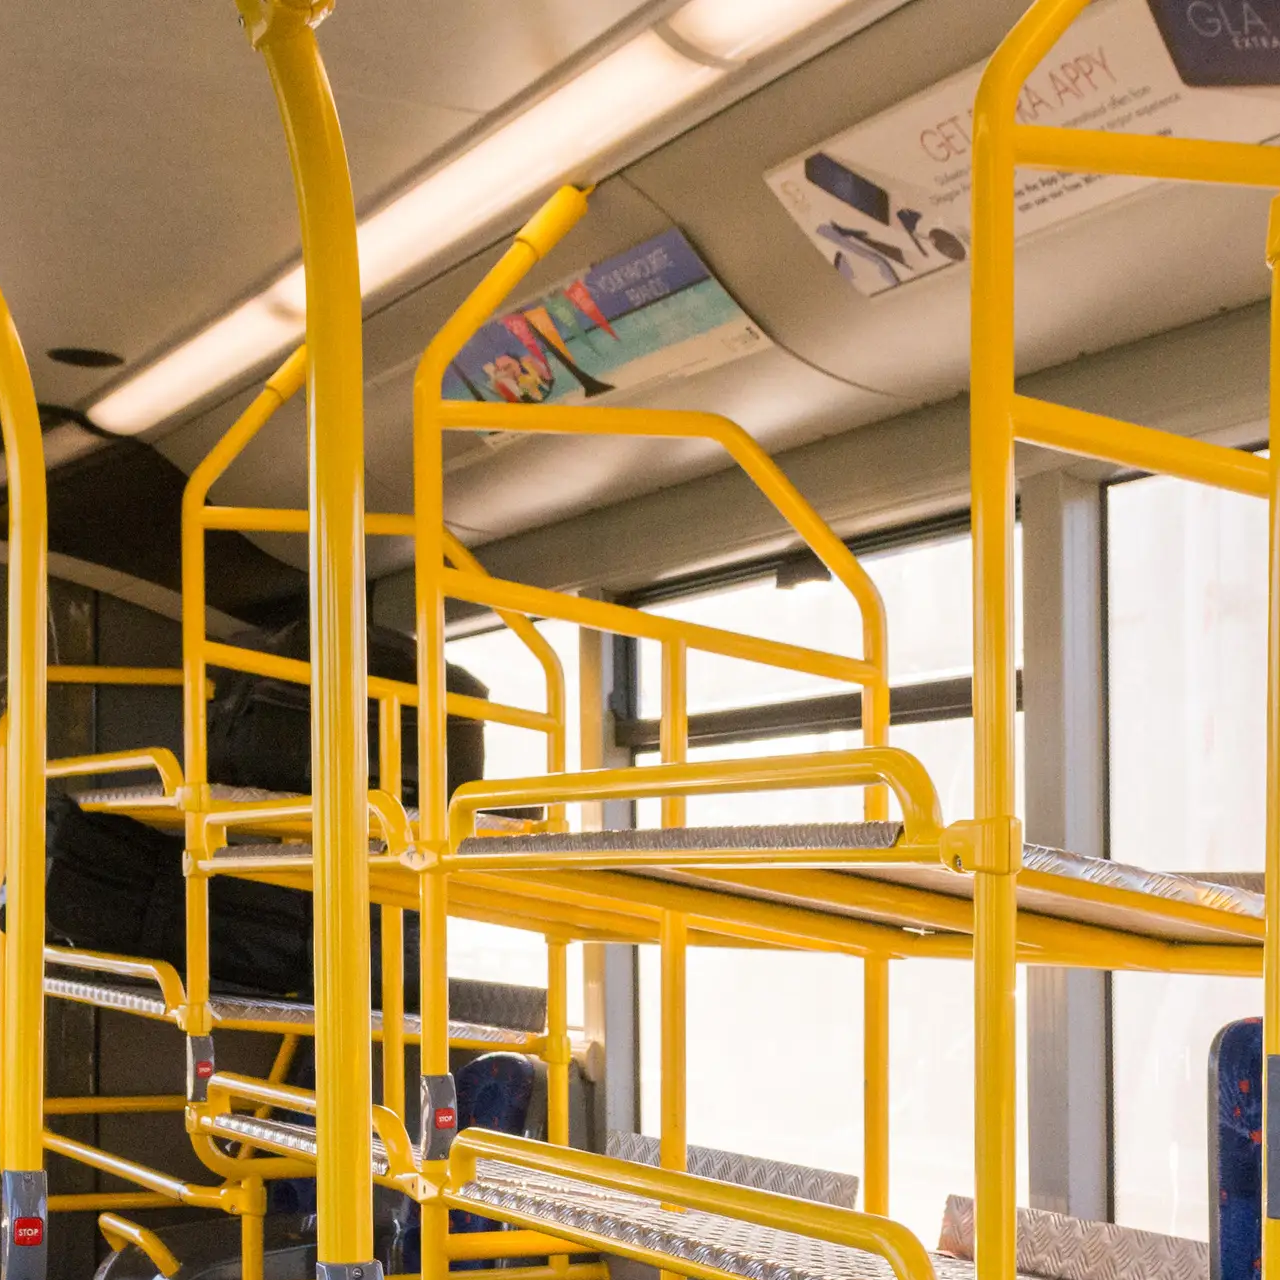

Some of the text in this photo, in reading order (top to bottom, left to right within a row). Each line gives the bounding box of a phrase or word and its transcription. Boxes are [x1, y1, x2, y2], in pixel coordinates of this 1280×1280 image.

[1186, 0, 1271, 38] GLA
[1048, 45, 1117, 107] APPY
[18, 1228, 39, 1237] STOP
